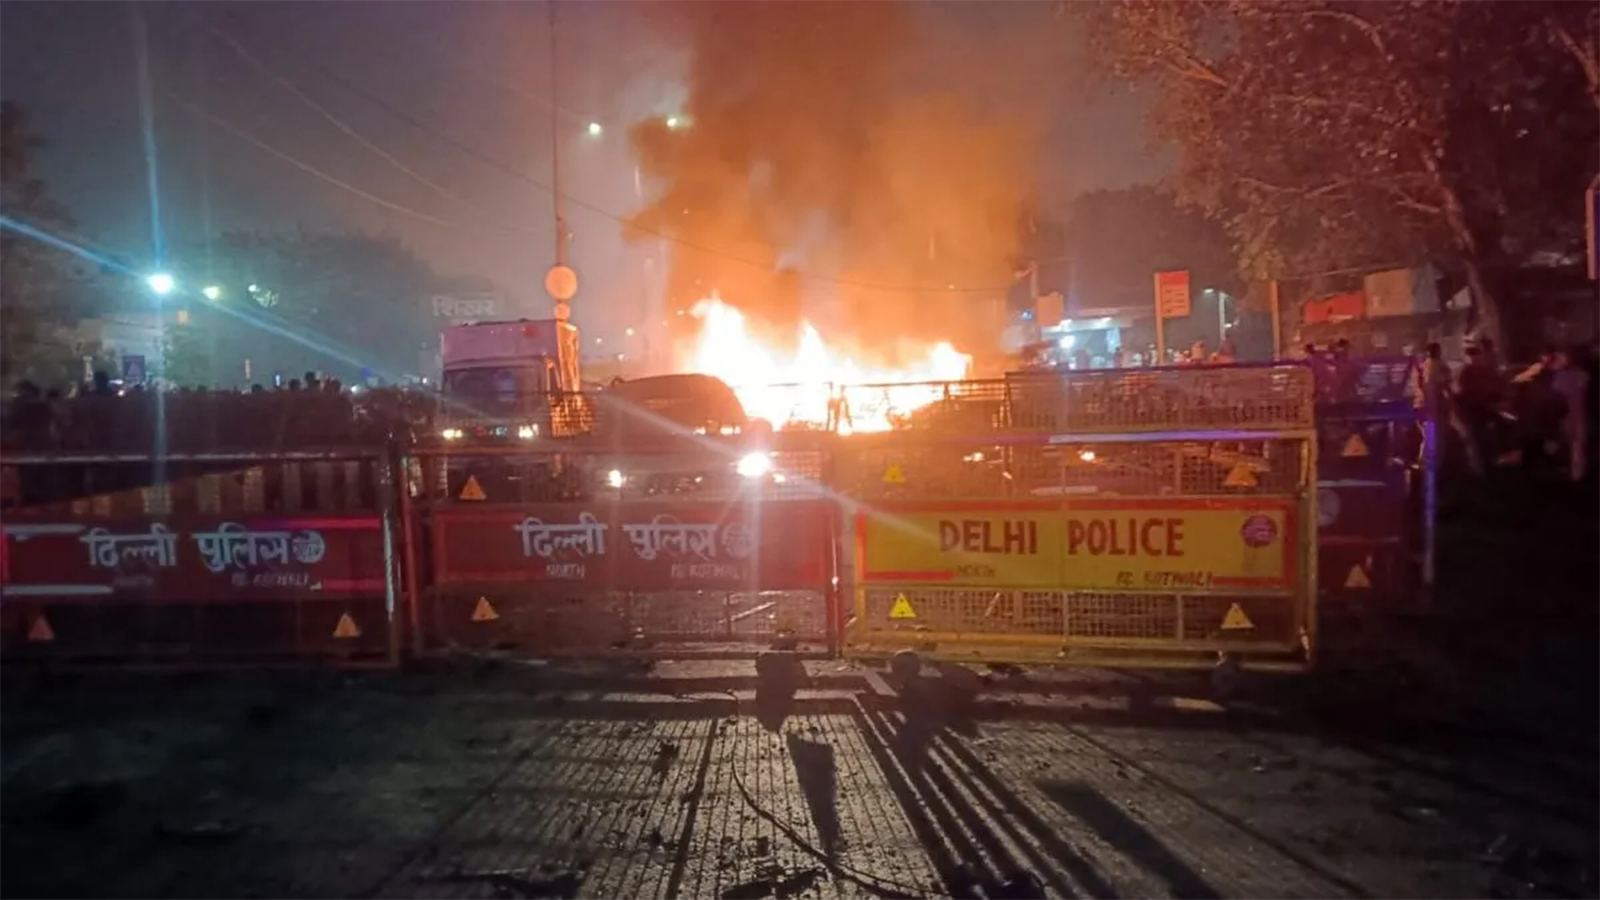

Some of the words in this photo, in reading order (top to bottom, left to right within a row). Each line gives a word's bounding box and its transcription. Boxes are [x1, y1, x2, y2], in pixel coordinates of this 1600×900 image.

[80, 522, 177, 567] दिल्ली
[192, 522, 291, 571] पुलिस
[513, 513, 607, 557] दिल्ली
[623, 514, 718, 561] पुलिस
[939, 520, 1037, 556] DELHI
[1068, 518, 1185, 557] POLICE
